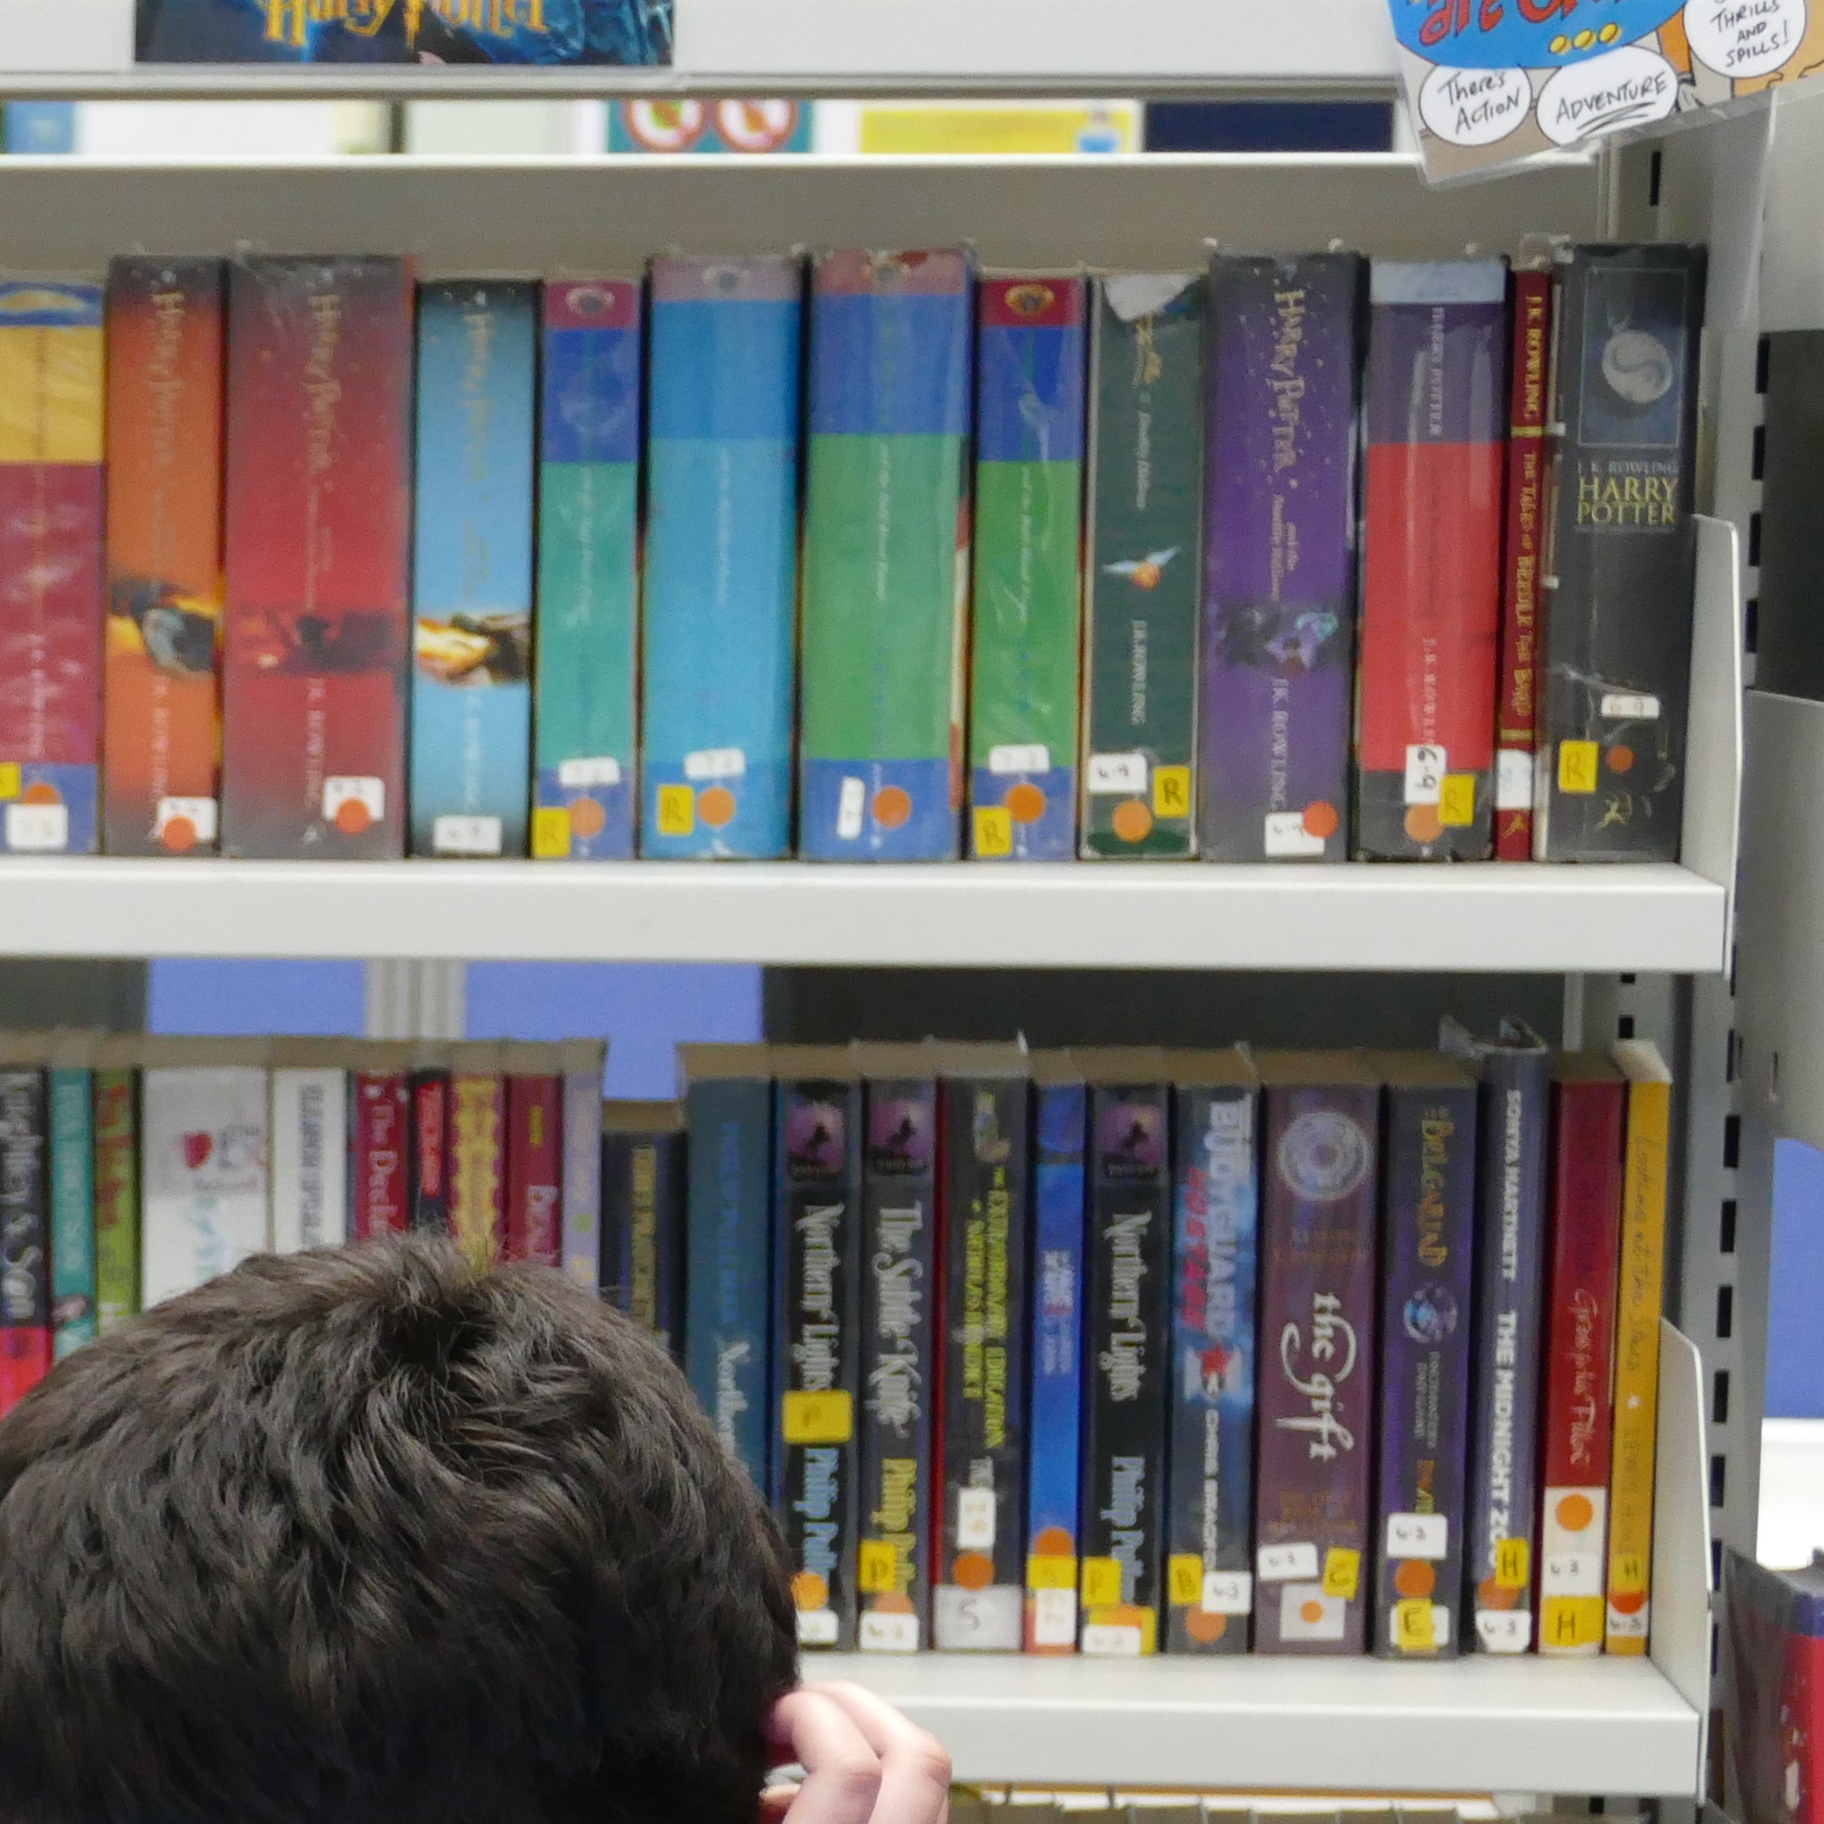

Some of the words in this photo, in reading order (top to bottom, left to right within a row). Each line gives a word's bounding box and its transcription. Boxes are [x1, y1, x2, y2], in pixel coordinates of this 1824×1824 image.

[1437, 71, 1506, 104] There's
[1454, 85, 1521, 134] ACTION
[1555, 71, 1668, 124] ADVENTURE
[1522, 331, 1544, 422] ROWLING
[1574, 500, 1679, 528] POTTER
[1576, 474, 1679, 503] HARRY
[1417, 667, 1440, 745] ROWLIN
[0, 1241, 40, 1321] Son
[1495, 1311, 1519, 1359] THE
[1274, 1374, 1355, 1462] gift
[1492, 1367, 1517, 1502] MIDNIGHT
